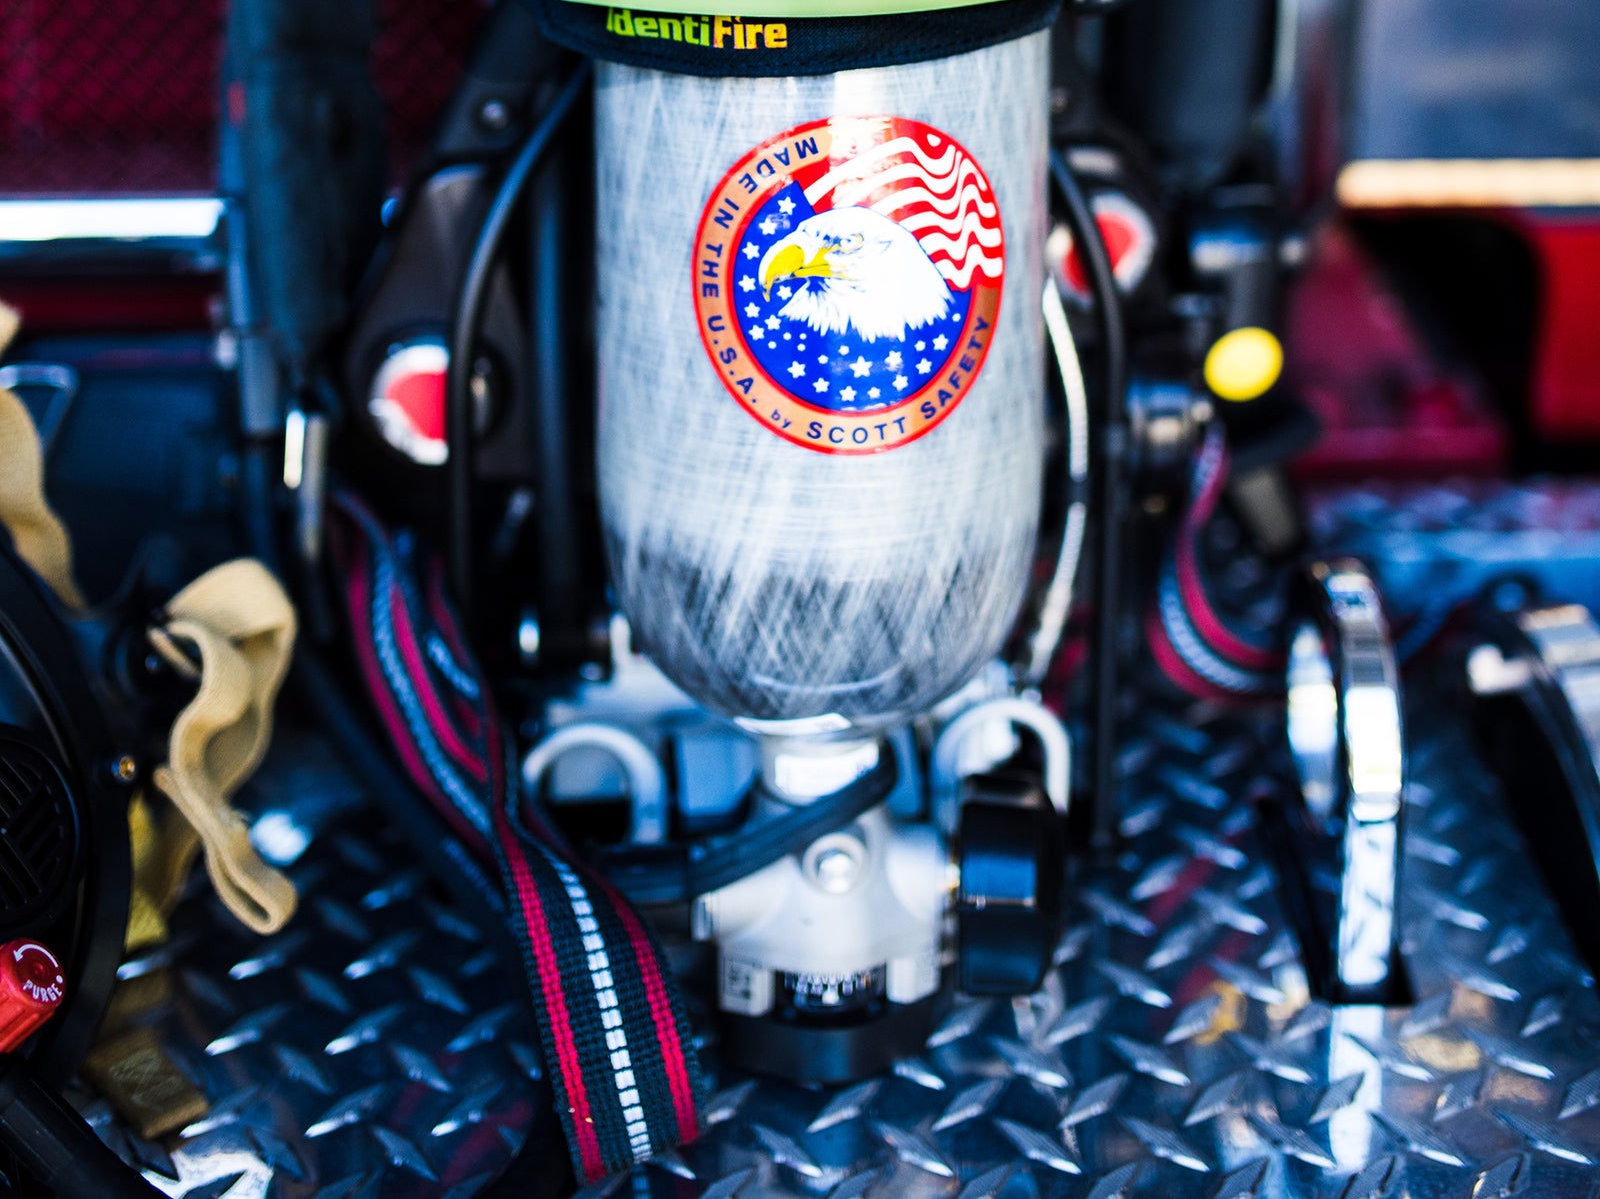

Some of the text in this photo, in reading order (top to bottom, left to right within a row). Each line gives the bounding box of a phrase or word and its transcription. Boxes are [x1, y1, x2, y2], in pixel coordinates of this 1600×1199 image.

[701, 136, 991, 445] MADE IN THE U.S.A. by SCOTT SAFETY
[23, 979, 62, 1002] PURGE
